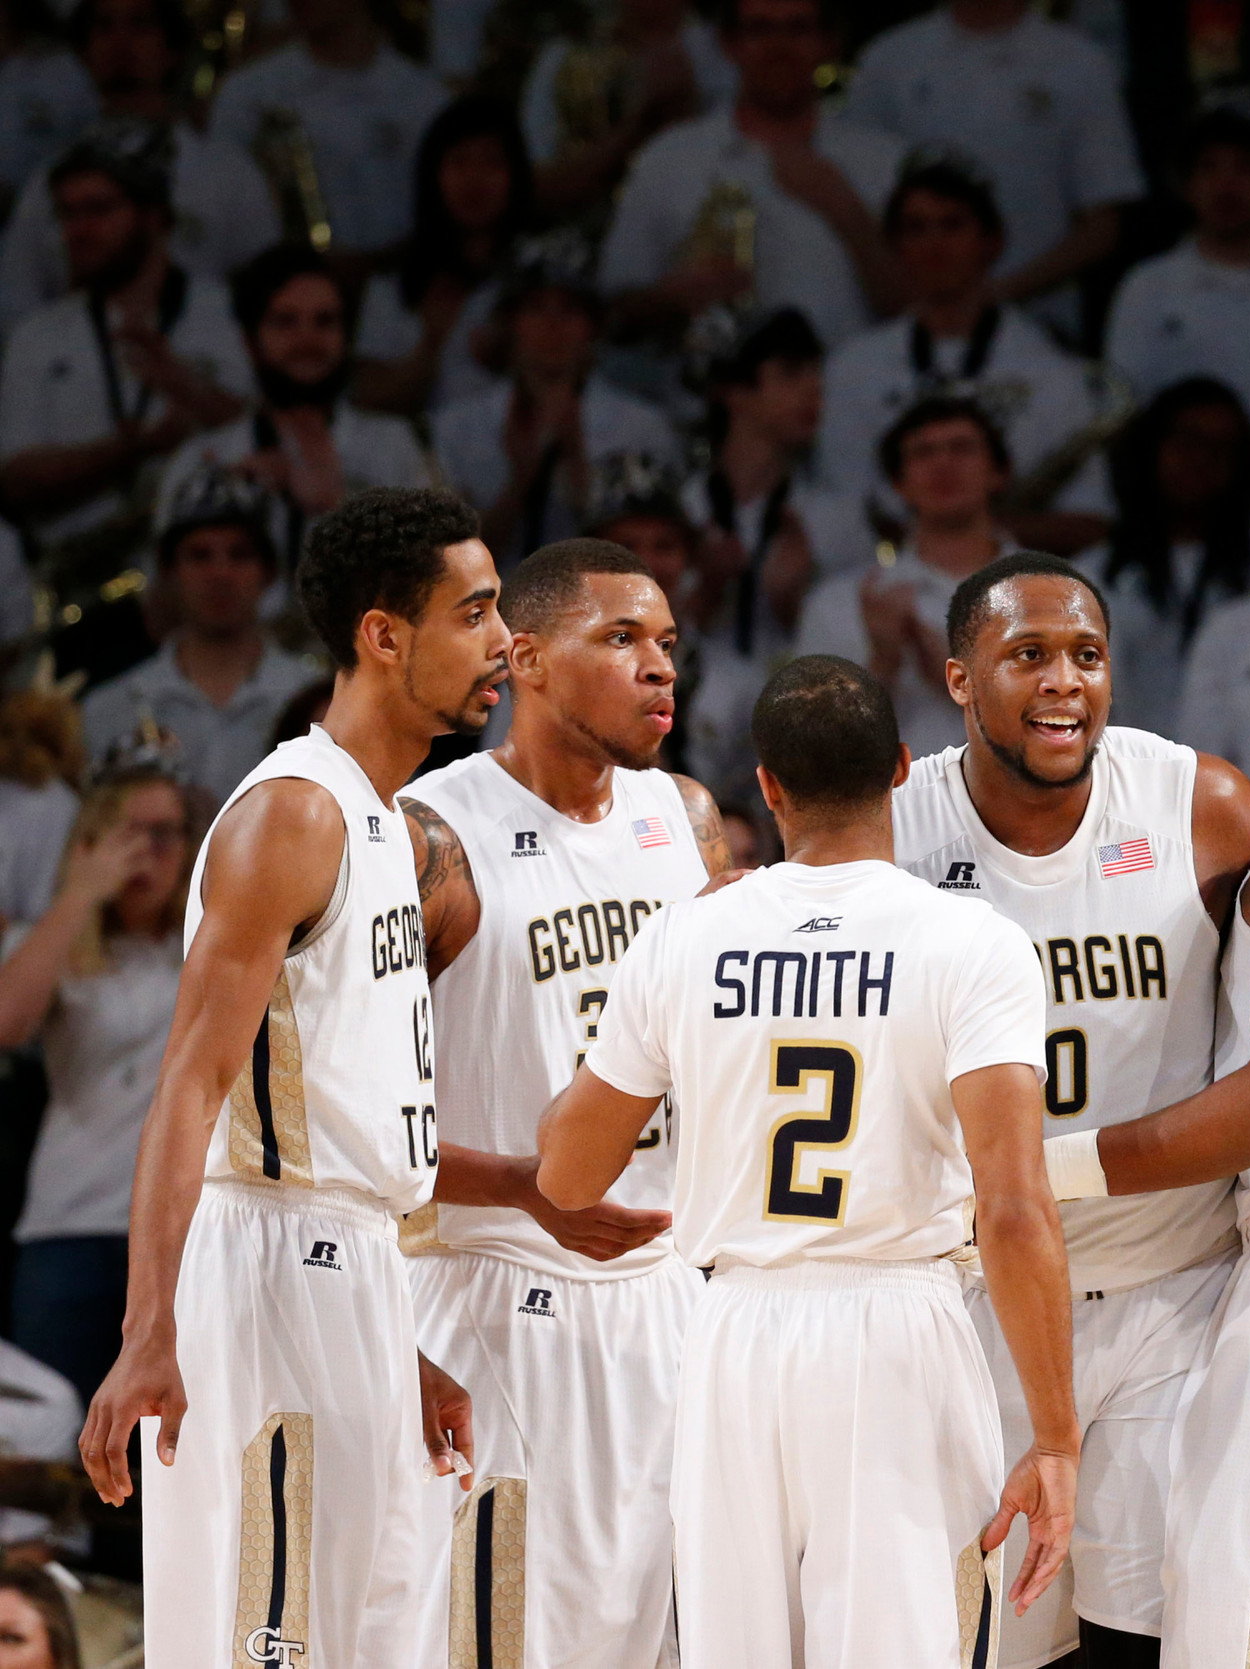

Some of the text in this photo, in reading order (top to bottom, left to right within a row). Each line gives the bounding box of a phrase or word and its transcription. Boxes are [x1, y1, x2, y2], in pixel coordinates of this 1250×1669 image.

[515, 831, 538, 850] R
[511, 850, 547, 858] RUSSELL
[945, 861, 976, 882] R
[937, 881, 982, 890] RUSSELL
[792, 916, 844, 933] ACC
[1036, 933, 1169, 1006] RGIA
[714, 950, 895, 1019] SMITH
[1043, 1026, 1090, 1121] 0
[762, 1038, 864, 1228] 2
[310, 1240, 338, 1262] R
[302, 1258, 343, 1271] RUSSELL
[525, 1287, 553, 1309] R
[517, 1305, 556, 1318] RUSSELL
